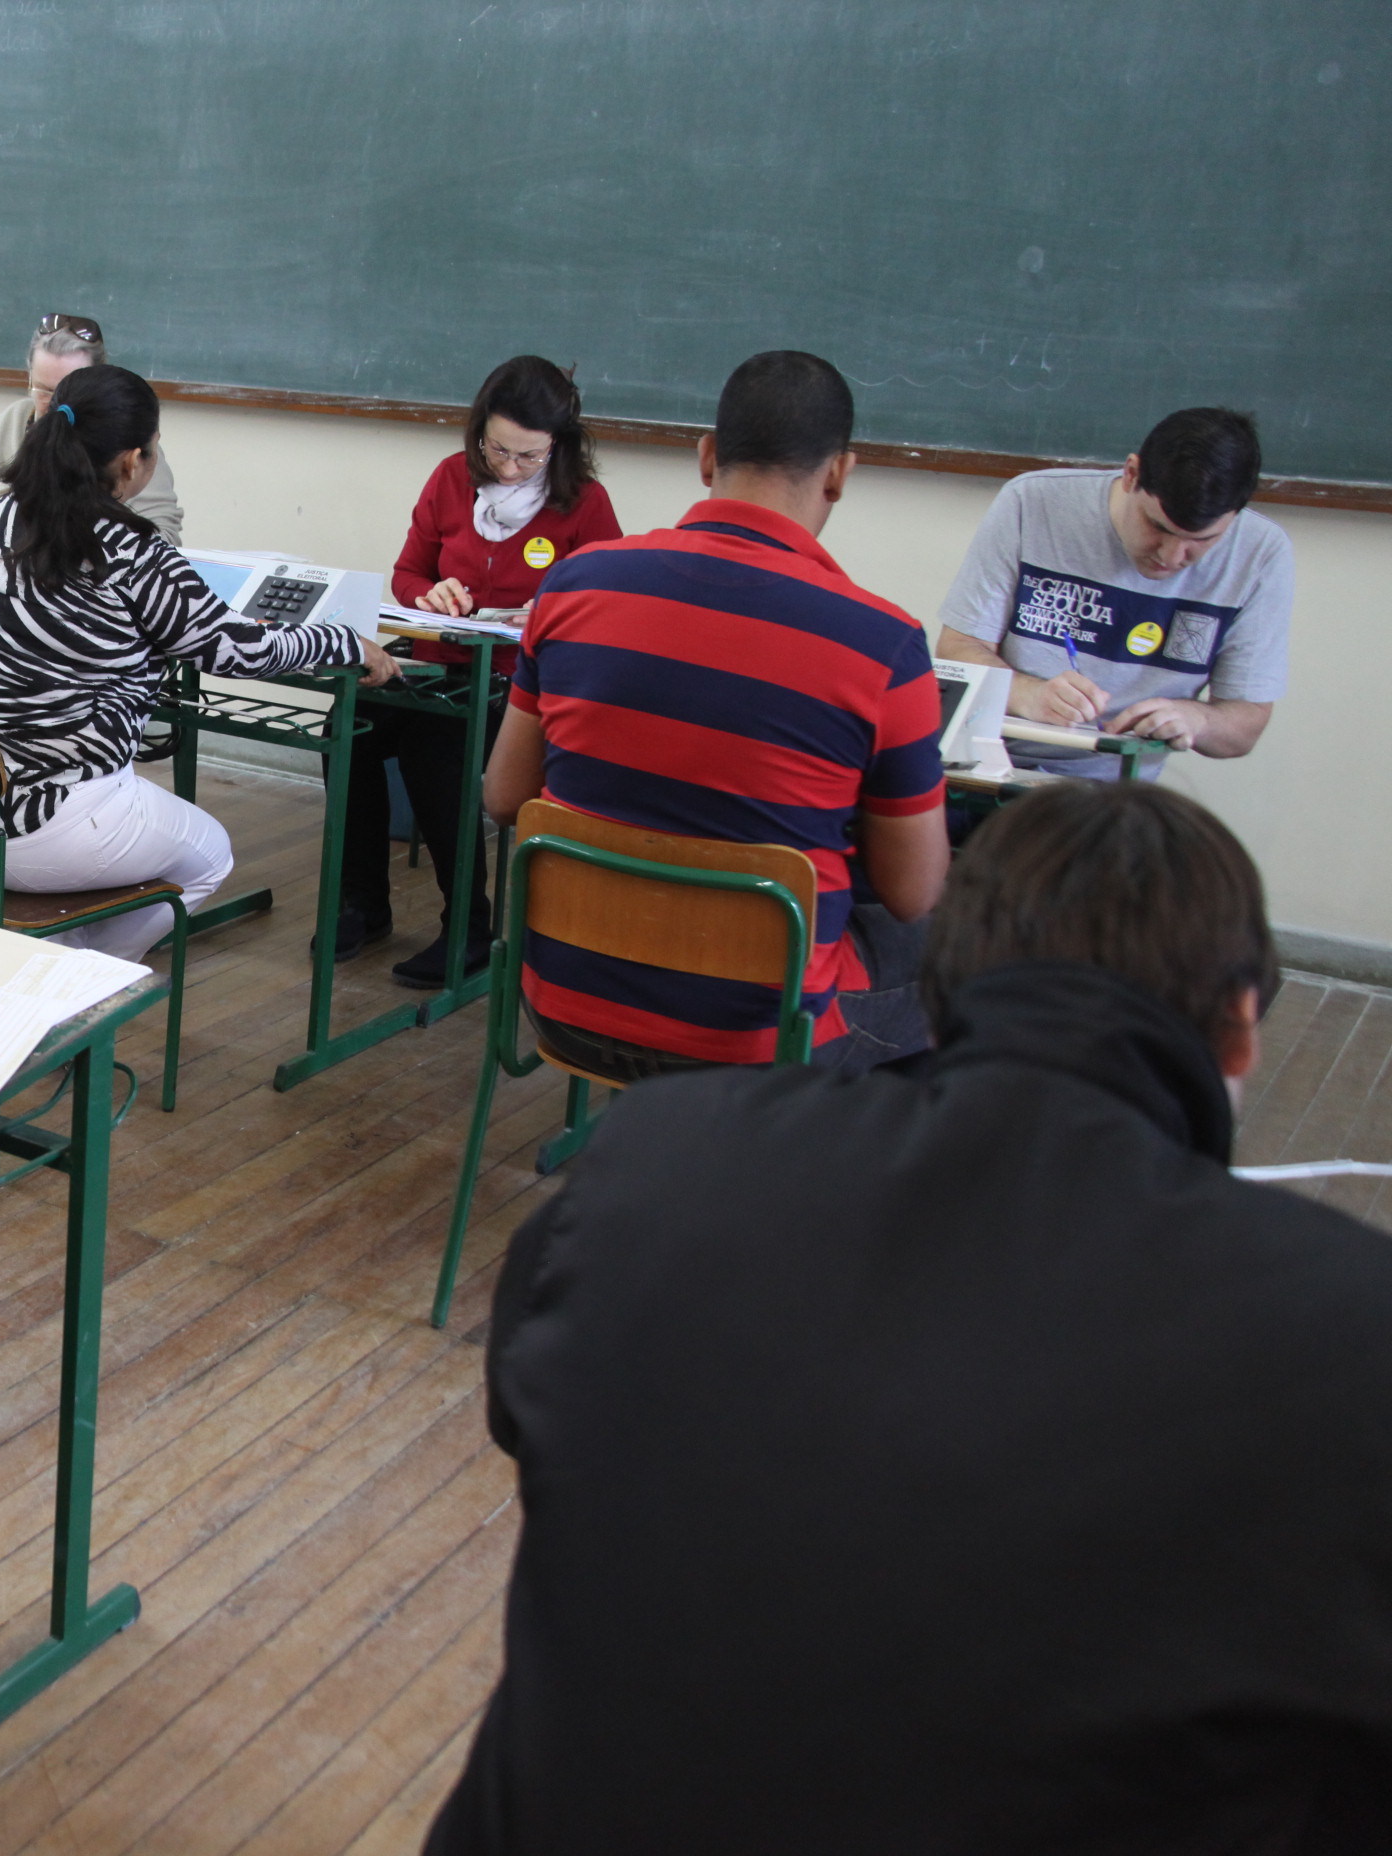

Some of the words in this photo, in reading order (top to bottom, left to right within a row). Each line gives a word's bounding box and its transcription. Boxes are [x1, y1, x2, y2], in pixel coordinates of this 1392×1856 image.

[1038, 578, 1104, 605] GIANT
[1017, 603, 1081, 628] REDWOODS
[1029, 589, 1114, 625] SEQUOIA
[1015, 613, 1069, 640] STATE
[1068, 627, 1098, 643] PARK
